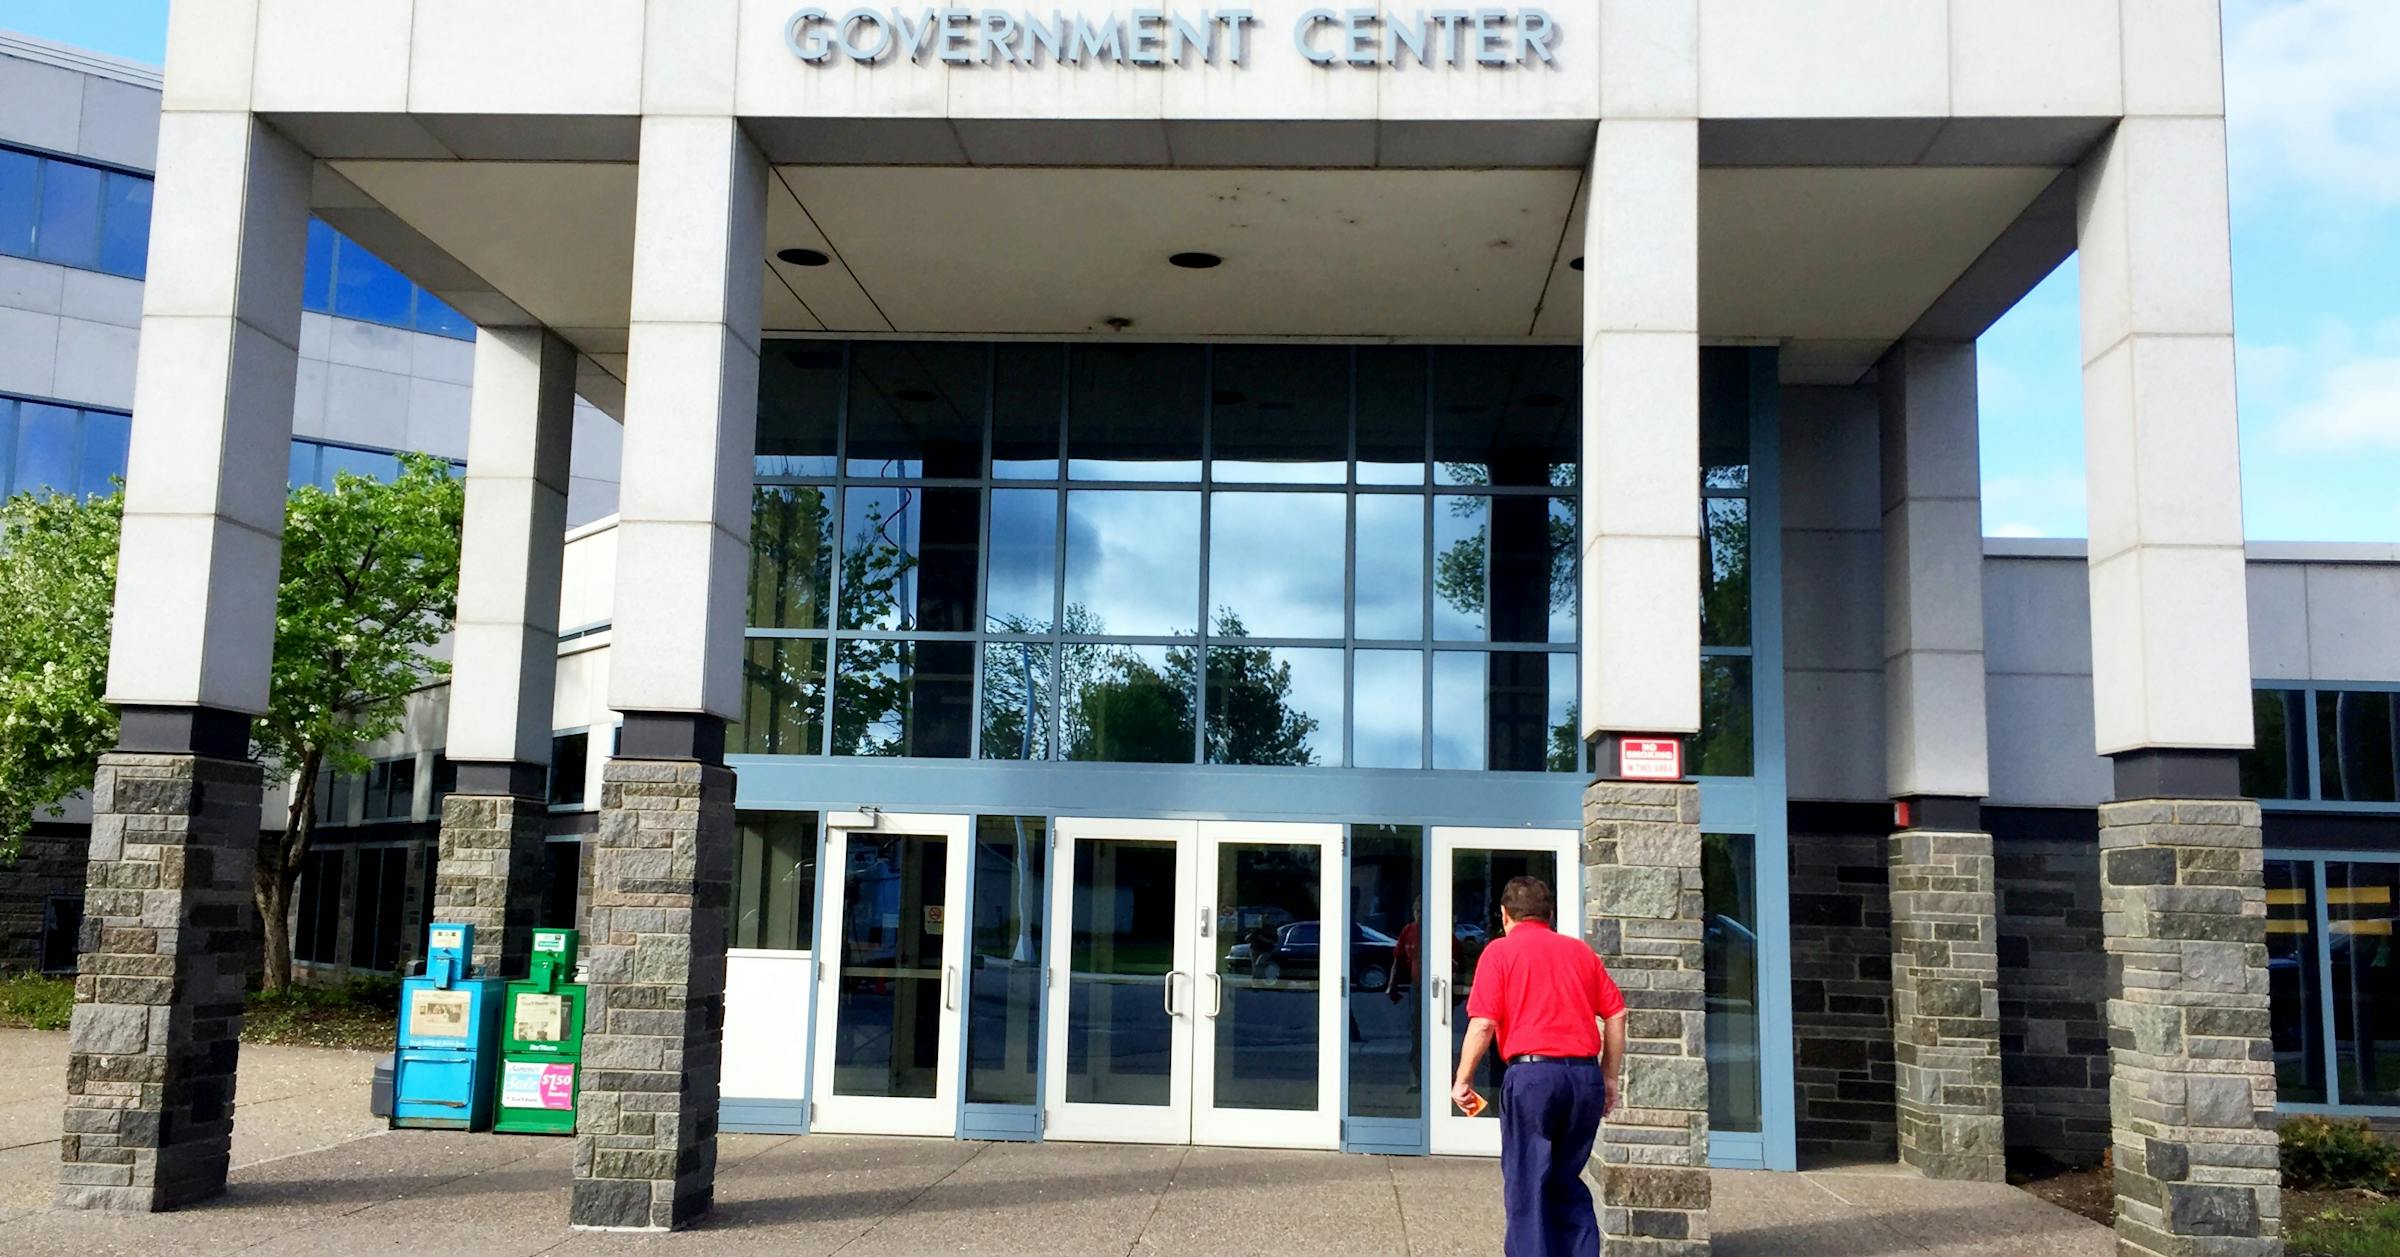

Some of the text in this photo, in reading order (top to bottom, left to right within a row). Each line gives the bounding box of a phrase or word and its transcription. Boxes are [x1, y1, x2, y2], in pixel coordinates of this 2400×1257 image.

[784, 8, 1553, 64] GOVERNMENT CENTER
[1642, 743, 1658, 752] NO
[1626, 751, 1673, 759] SMOKING
